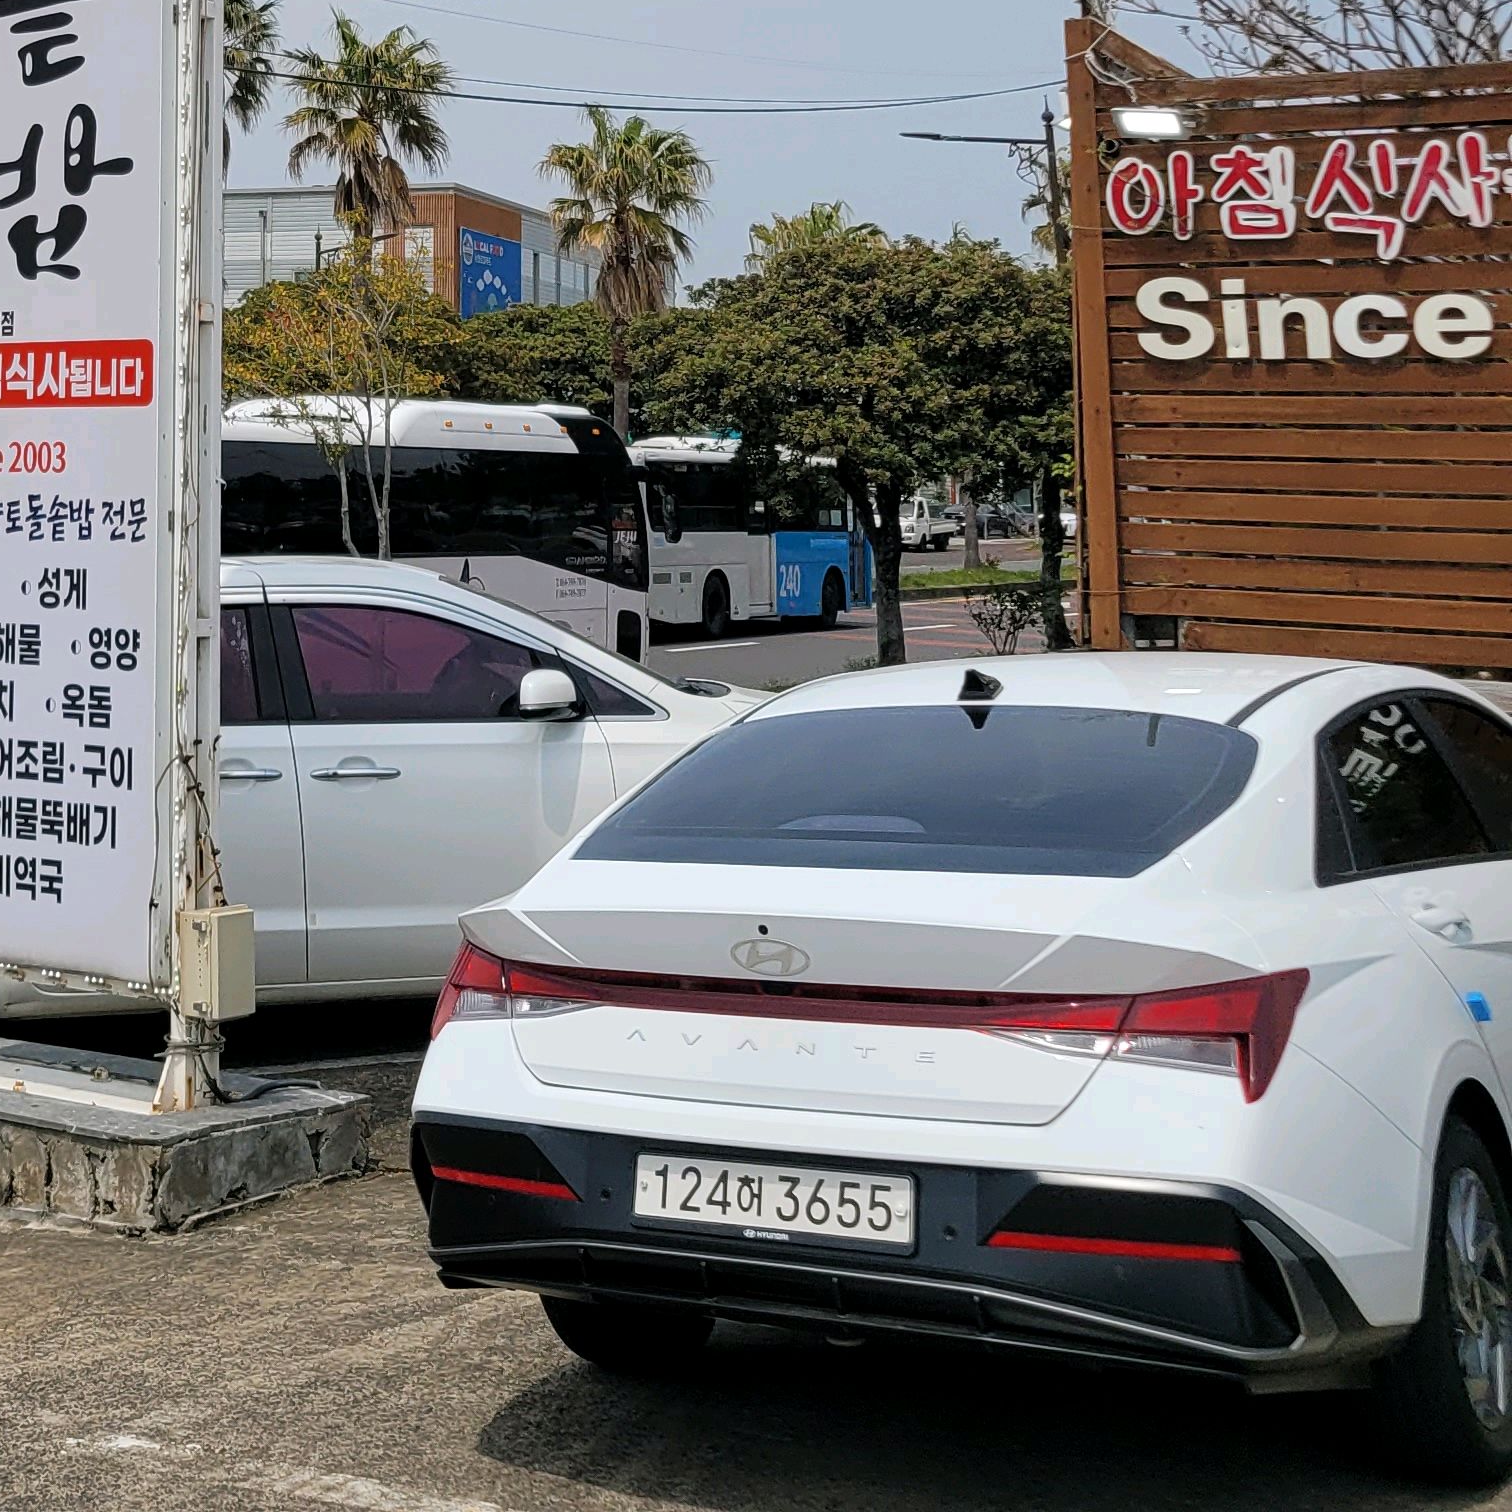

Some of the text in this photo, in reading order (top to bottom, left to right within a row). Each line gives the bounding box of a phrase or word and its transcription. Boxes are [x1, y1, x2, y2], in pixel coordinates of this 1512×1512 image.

[1106, 131, 1512, 260] 아침식사
[1136, 277, 1494, 360] Since
[8, 441, 67, 474] 2003
[101, 498, 148, 543] 전문
[38, 567, 88, 610] 성게
[779, 564, 801, 598] 240
[89, 627, 141, 671] 영양
[61, 683, 112, 729] 옥돔
[626, 1029, 936, 1064] AVANTE
[654, 1163, 893, 1232] 124허 3655
